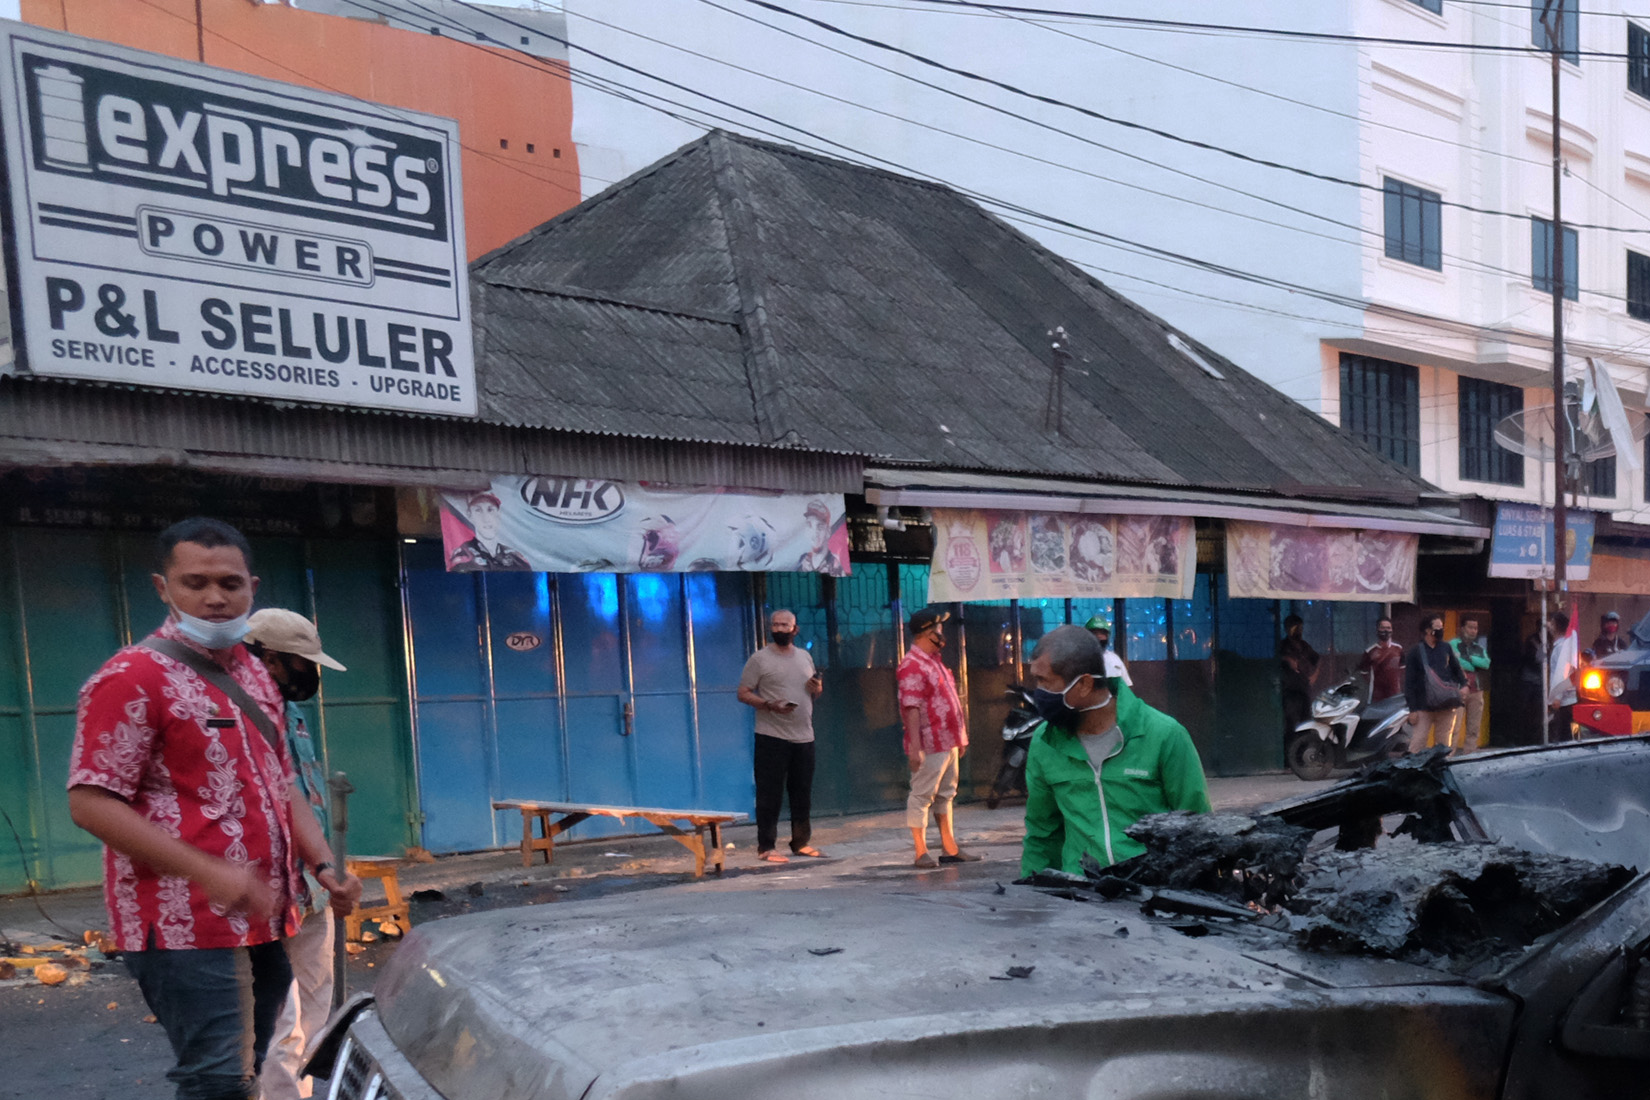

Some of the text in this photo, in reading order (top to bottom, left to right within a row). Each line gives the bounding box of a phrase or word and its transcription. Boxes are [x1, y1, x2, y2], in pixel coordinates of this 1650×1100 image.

[97, 94, 432, 215] express
[148, 215, 364, 279] POWER
[45, 276, 458, 378] P&L SELULER
[52, 339, 155, 368] SERVICE
[190, 354, 340, 388] ACCESSORIES
[370, 374, 461, 403] UPGRADE
